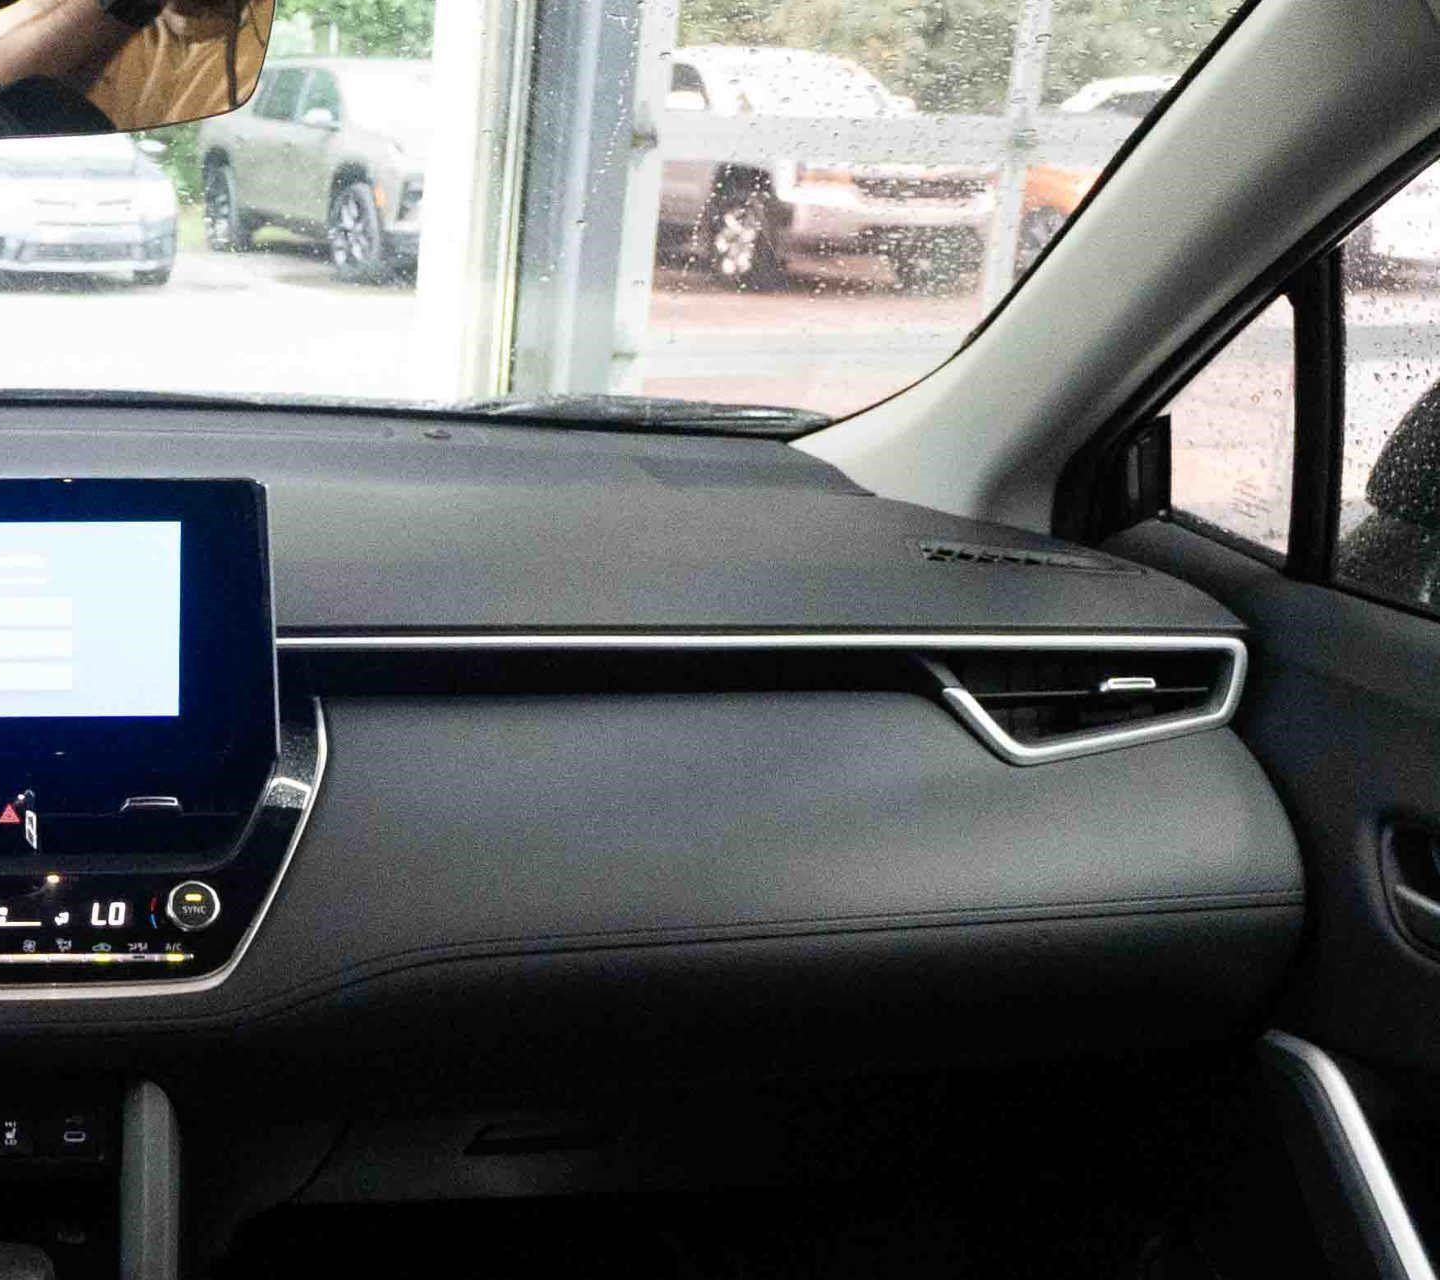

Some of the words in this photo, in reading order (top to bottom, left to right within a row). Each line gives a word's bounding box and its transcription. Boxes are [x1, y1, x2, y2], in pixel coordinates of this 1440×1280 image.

[91, 902, 126, 926] LO
[182, 905, 207, 915] SYNC
[165, 942, 182, 952] A/C
